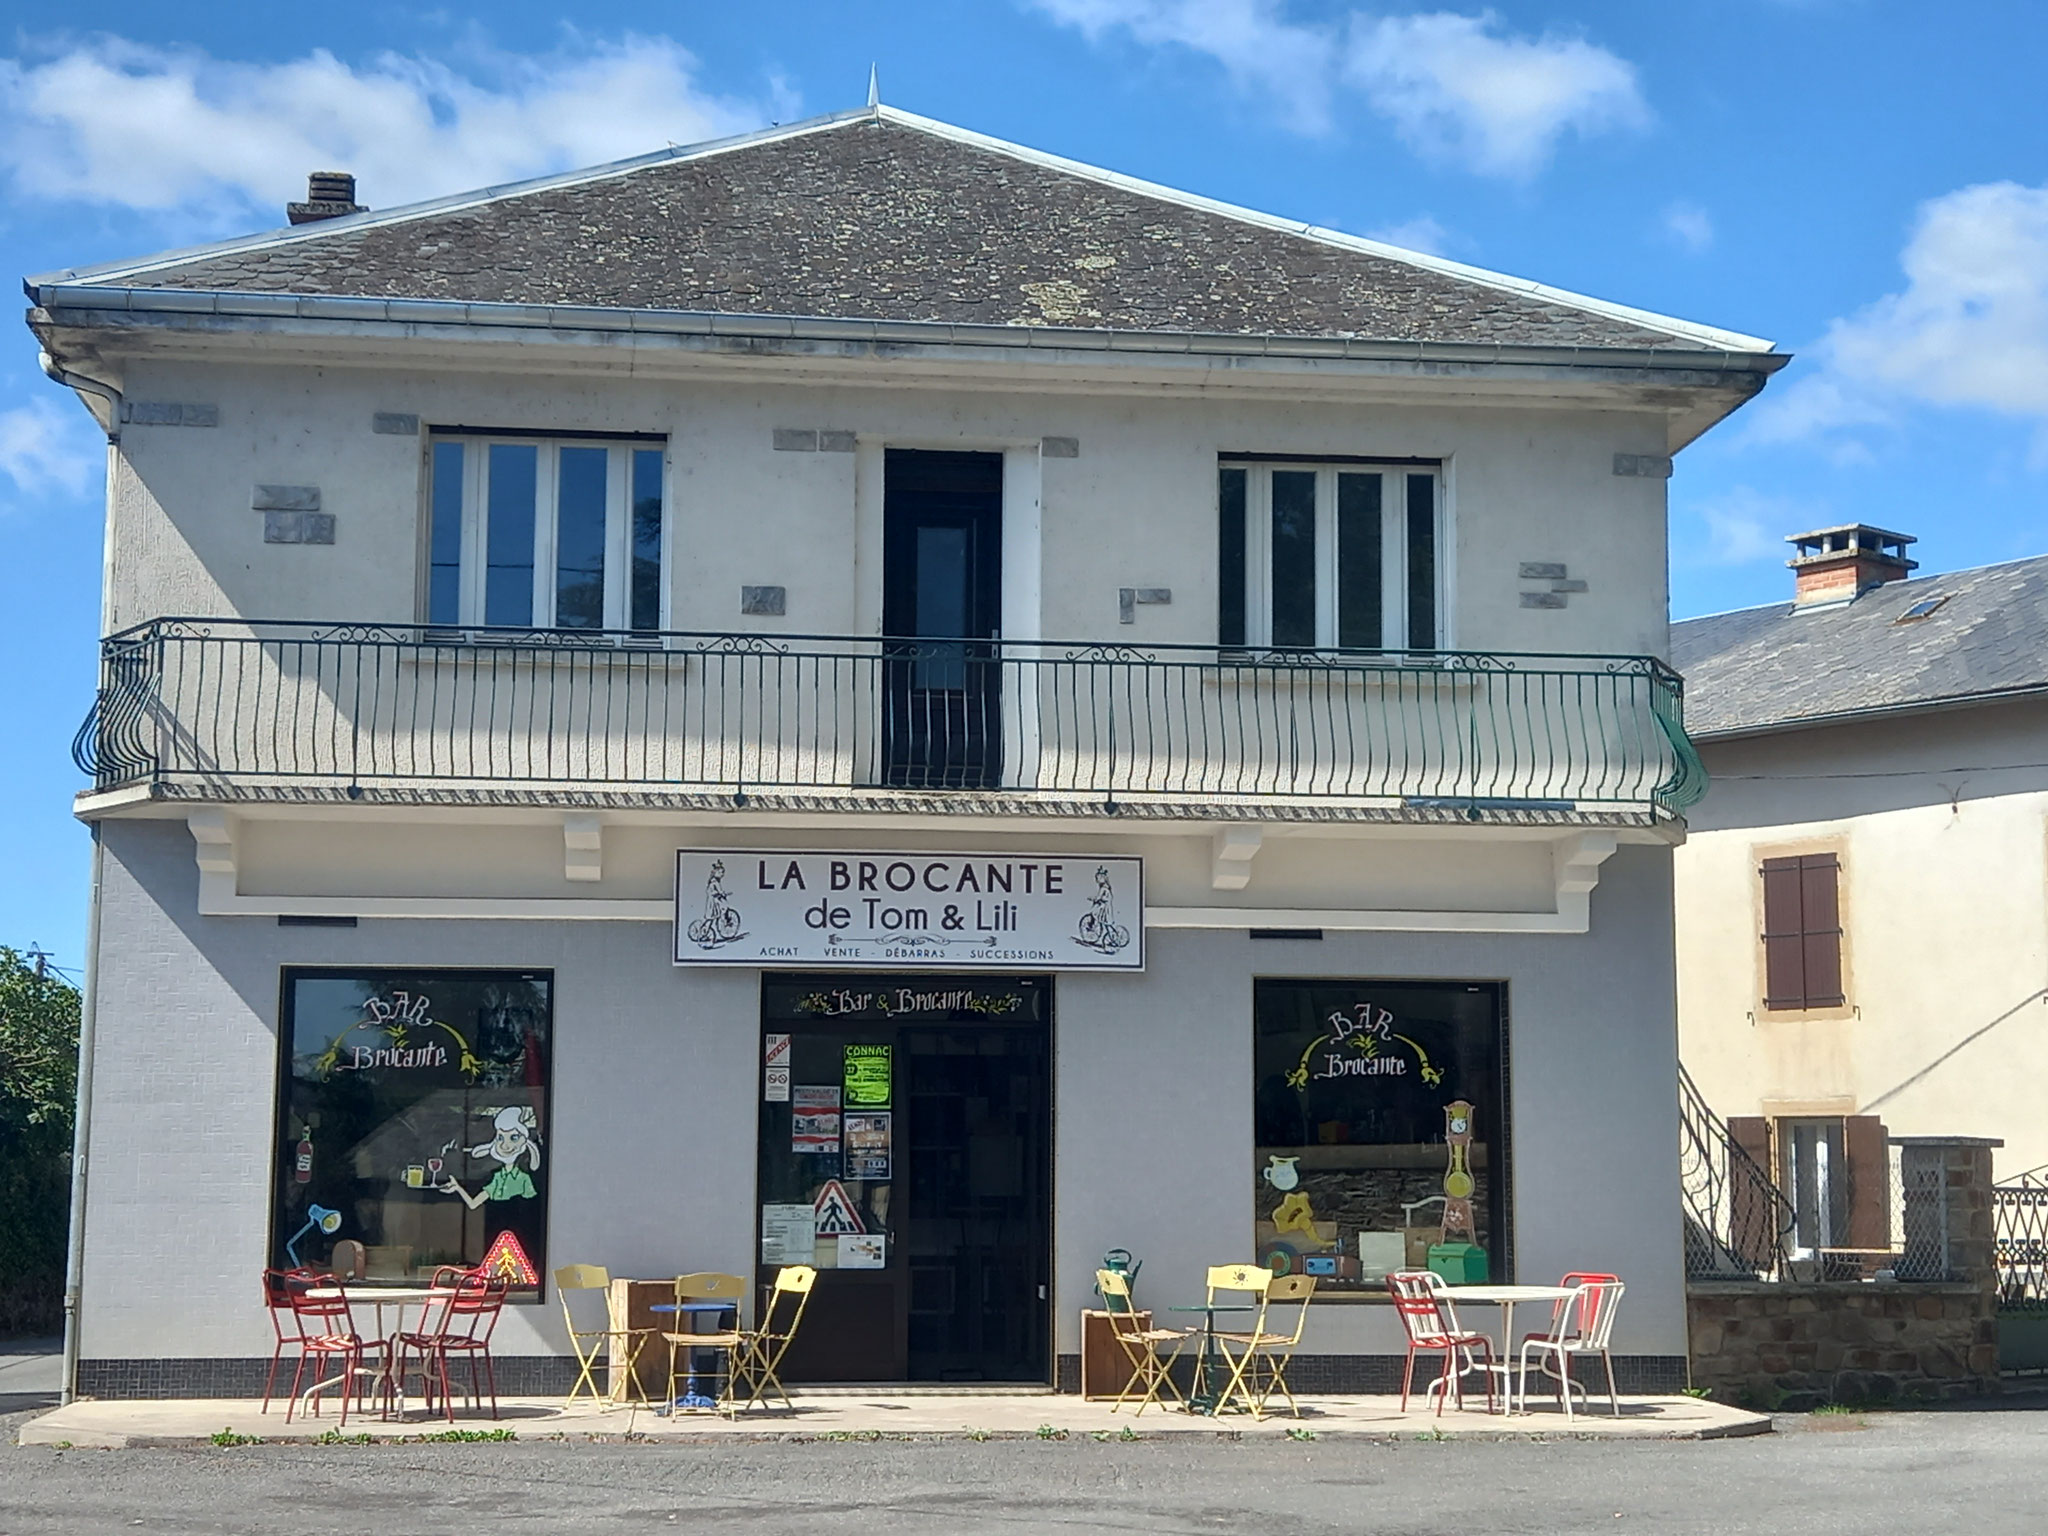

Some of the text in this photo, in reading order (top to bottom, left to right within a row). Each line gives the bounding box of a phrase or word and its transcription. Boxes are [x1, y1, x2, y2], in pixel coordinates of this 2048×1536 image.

[758, 860, 1063, 894] LA BROCANTE
[804, 897, 1018, 932] de Tom & Lili
[759, 946, 1054, 960] ACHAT VENTE DÉBARRAS SUCCESSIONS
[358, 991, 434, 1030] BAR
[826, 988, 873, 1016] Bar
[887, 987, 975, 1017] Brocante
[1327, 1002, 1393, 1045] BAR
[335, 1040, 448, 1072] Brocante
[1313, 1053, 1408, 1080] Brocante
